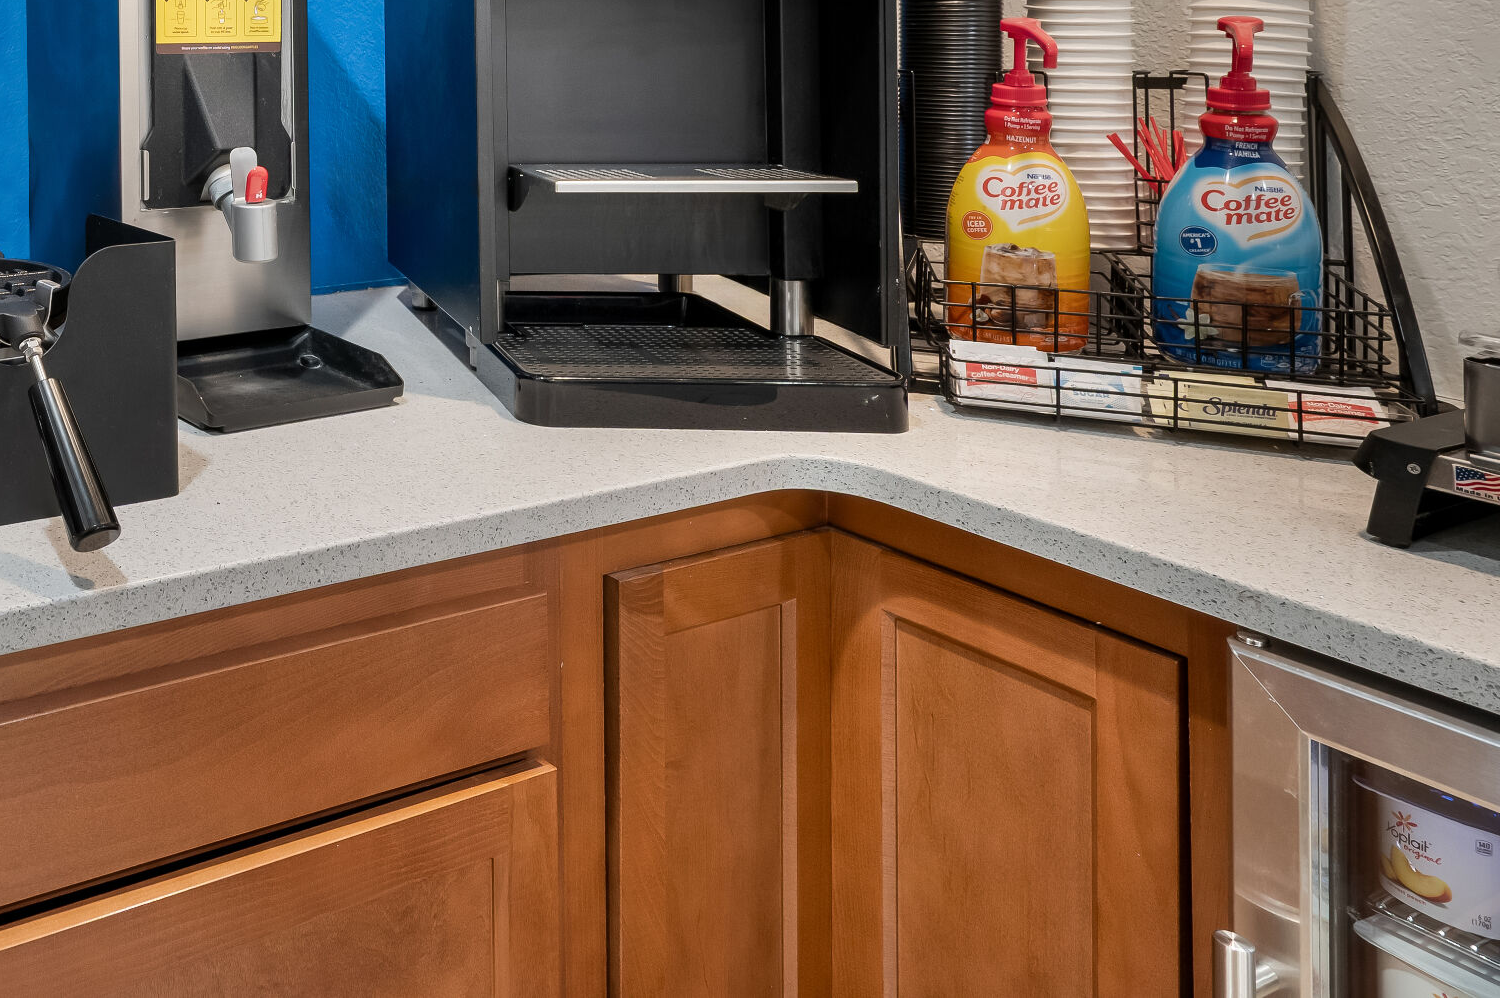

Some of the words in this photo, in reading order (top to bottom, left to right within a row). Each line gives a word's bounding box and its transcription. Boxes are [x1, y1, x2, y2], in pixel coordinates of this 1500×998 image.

[1006, 134, 1037, 144] HAZELNUT
[1235, 142, 1259, 150] FRENCH
[1233, 149, 1261, 159] VANILLA
[982, 176, 1059, 198] Coffee
[1000, 192, 1061, 210] mate
[1201, 189, 1292, 211] Coffee
[1225, 206, 1296, 225] mate
[966, 220, 986, 228] ICED
[981, 363, 1020, 374] Non-Dairy
[996, 371, 1029, 381] Creamer
[1073, 389, 1110, 399] SUGAR
[1202, 397, 1277, 417] Splenda
[1306, 401, 1352, 410] Non-Dairy
[1456, 486, 1482, 497] Made
[1484, 492, 1494, 500] in
[1386, 821, 1429, 853] Yoplait
[1478, 841, 1491, 850] 140
